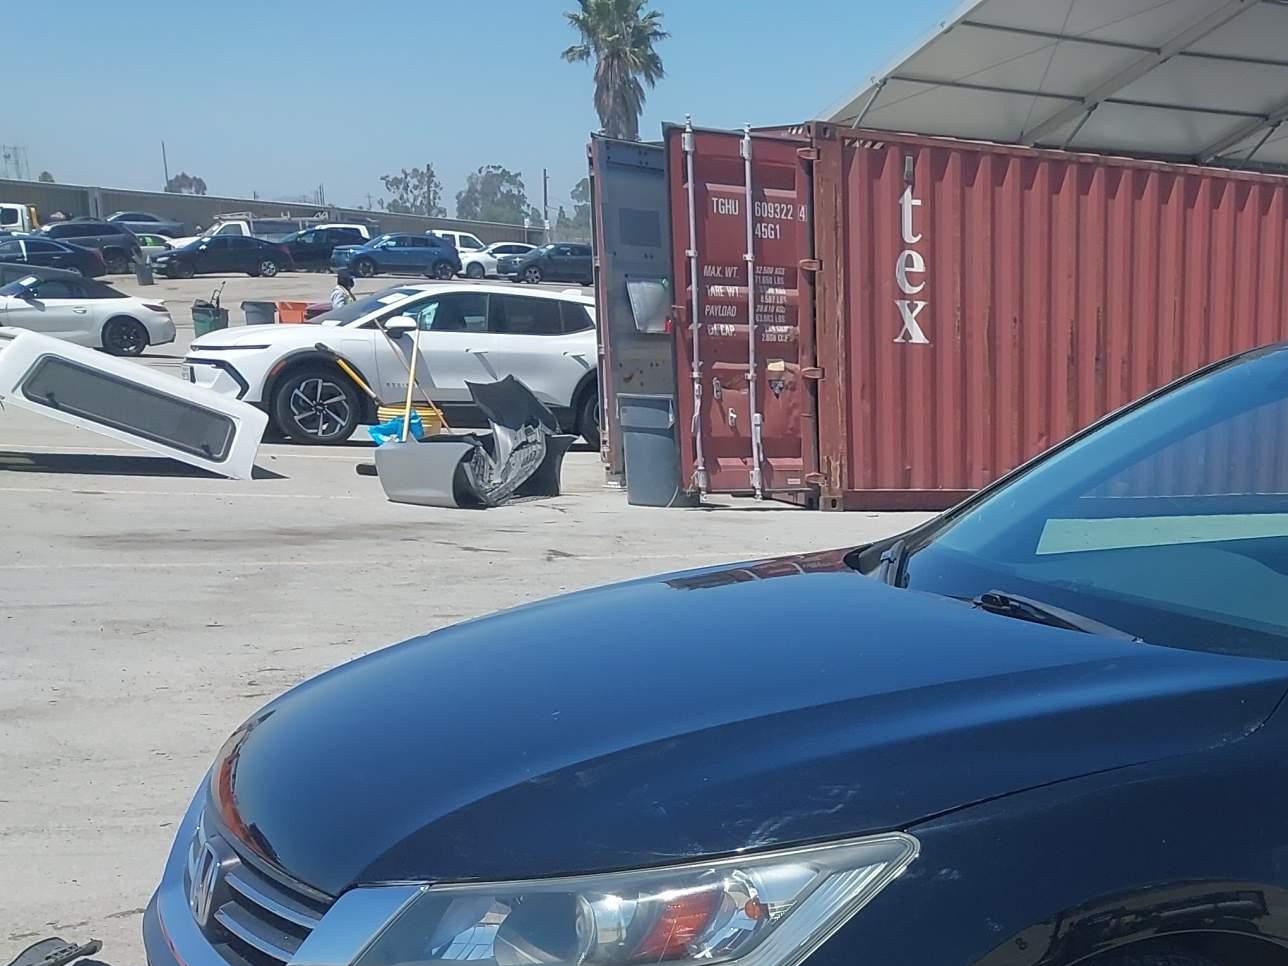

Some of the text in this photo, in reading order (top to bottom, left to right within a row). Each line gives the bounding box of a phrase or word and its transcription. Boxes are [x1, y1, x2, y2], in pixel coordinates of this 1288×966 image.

[712, 197, 739, 215] TGHU
[754, 202, 793, 220] 609322
[754, 223, 781, 240] 45G1
[893, 185, 930, 344] tex
[704, 304, 737, 317] PAYLOAD
